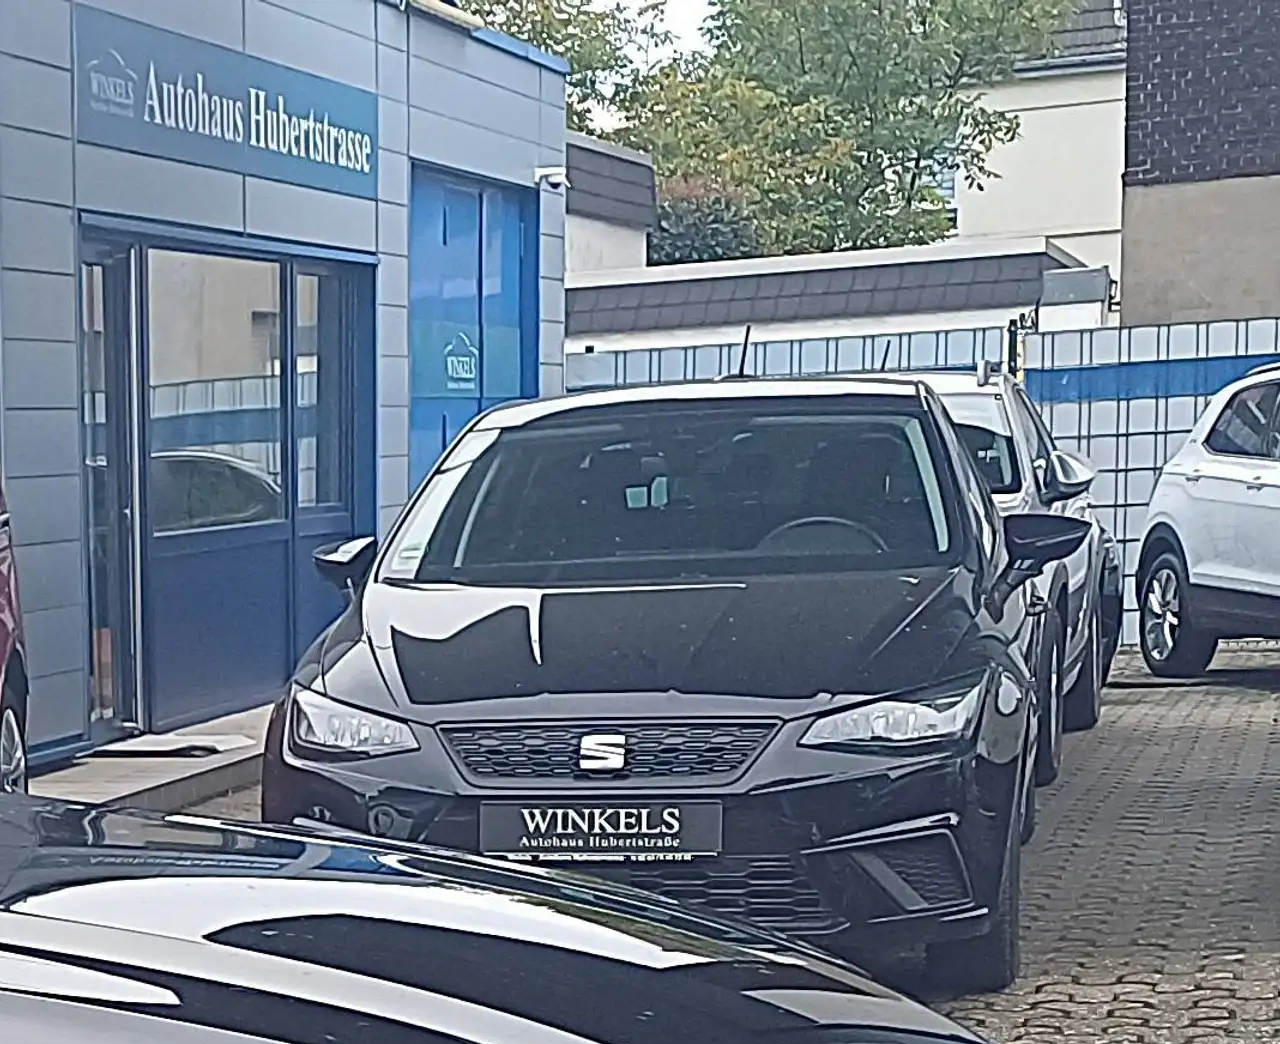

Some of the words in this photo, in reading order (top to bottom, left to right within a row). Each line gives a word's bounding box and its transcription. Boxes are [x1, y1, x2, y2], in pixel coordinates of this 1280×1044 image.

[143, 59, 244, 143] Autohaus
[248, 87, 372, 174] Hubertstrasse
[520, 807, 680, 834] WINKELS
[519, 836, 584, 848] Autohaus
